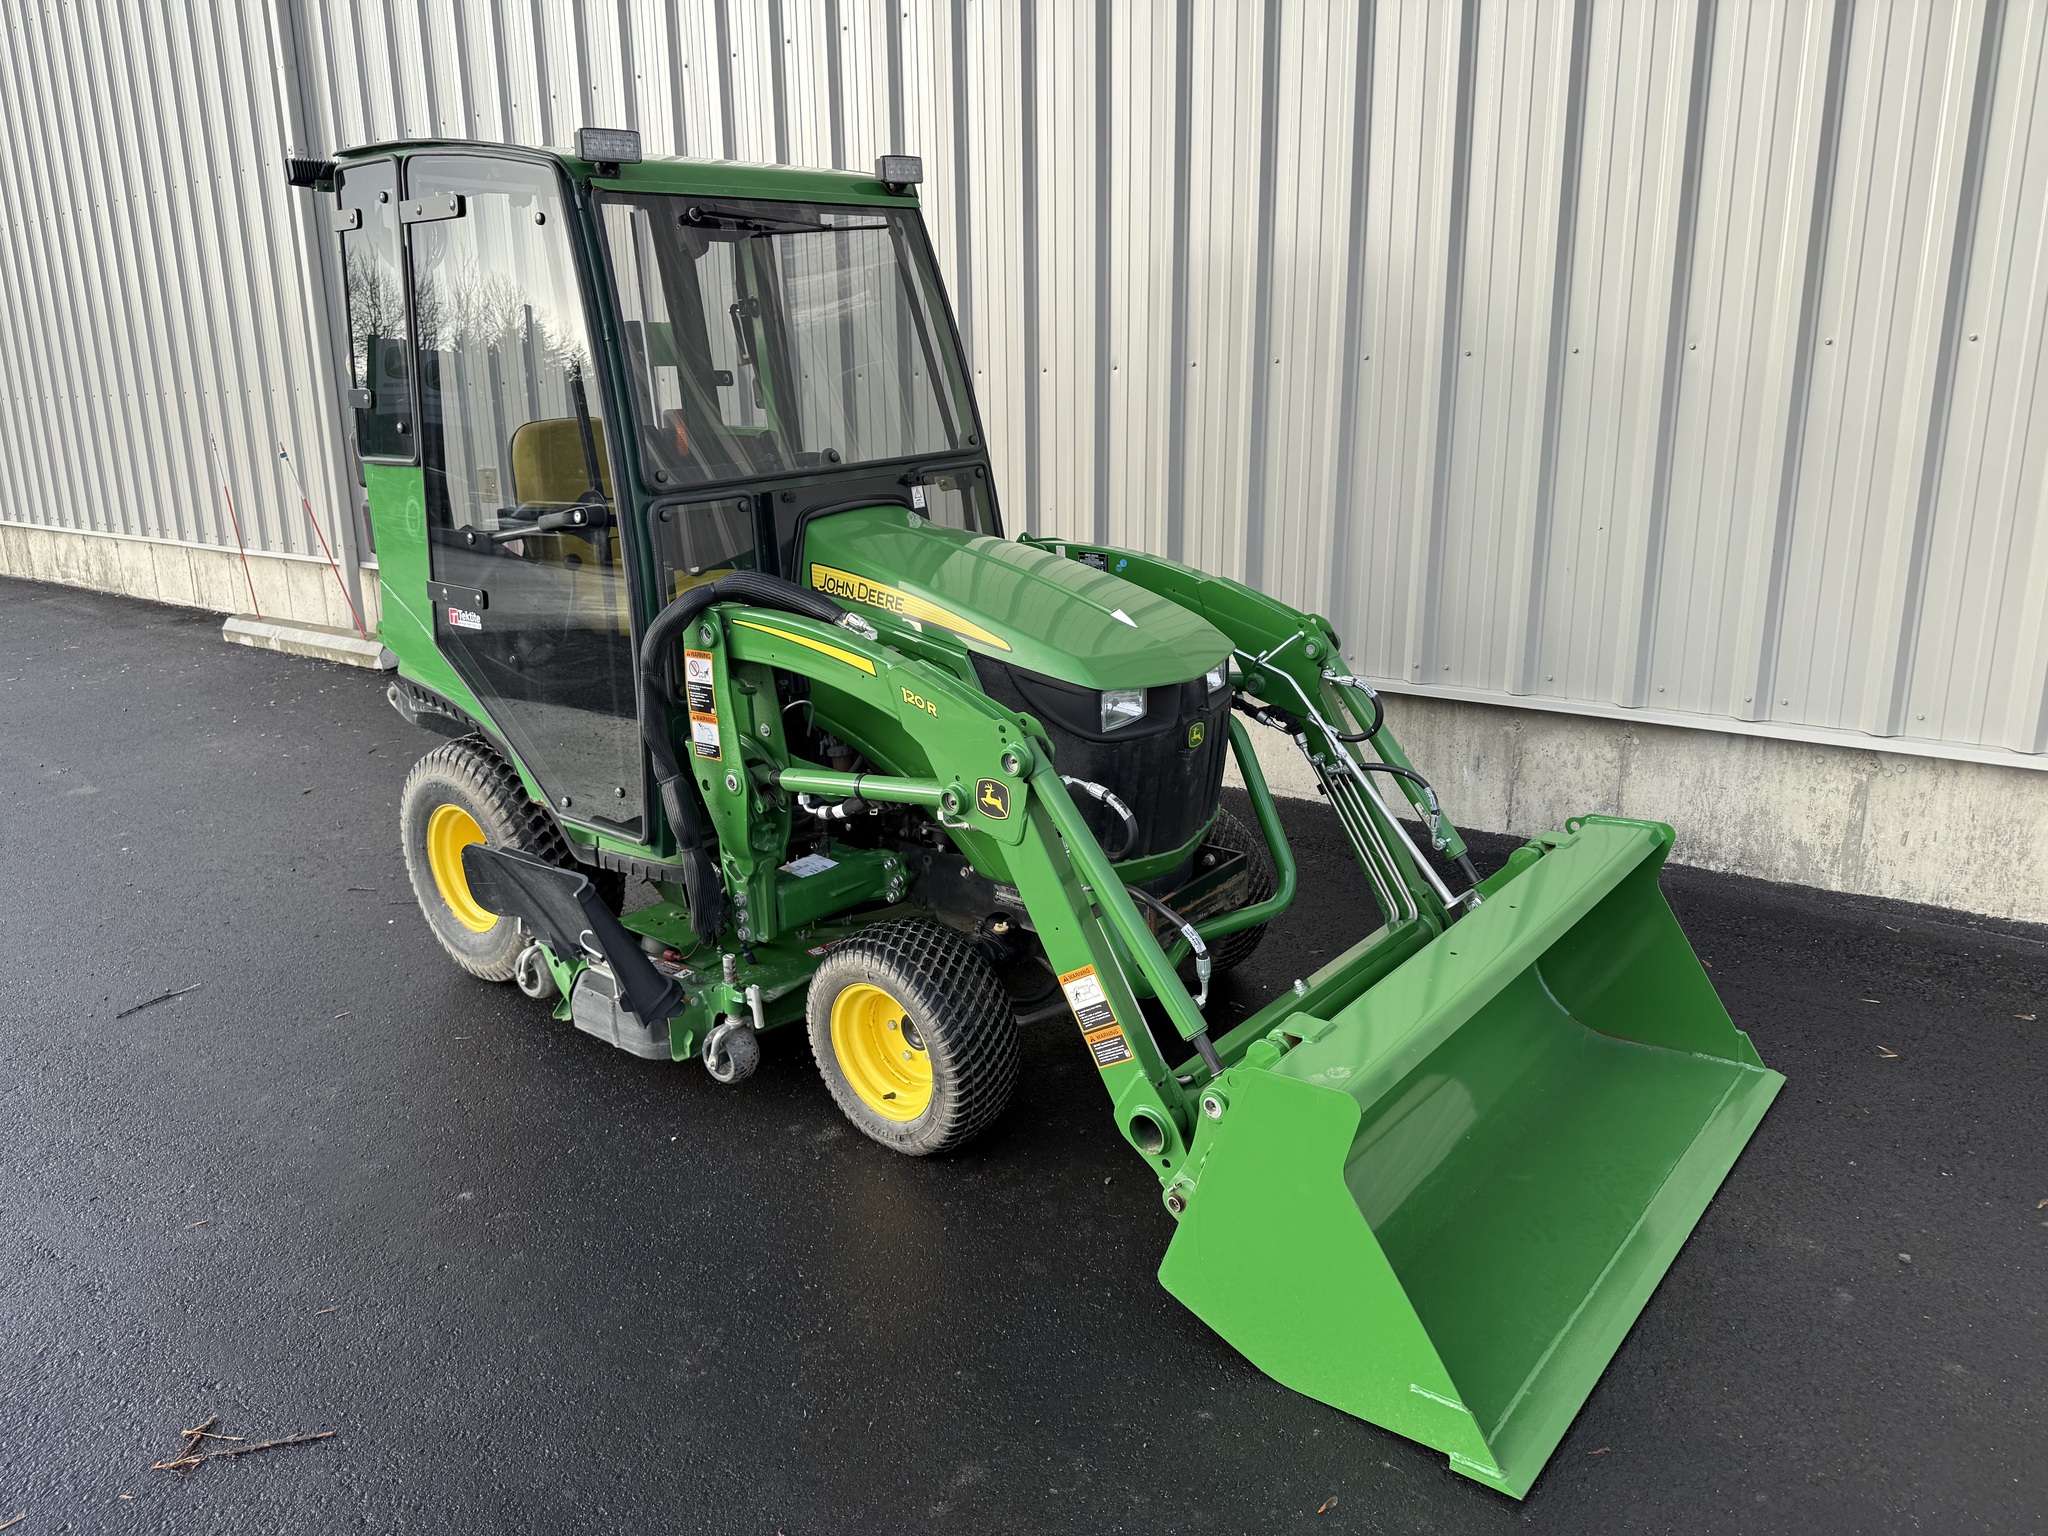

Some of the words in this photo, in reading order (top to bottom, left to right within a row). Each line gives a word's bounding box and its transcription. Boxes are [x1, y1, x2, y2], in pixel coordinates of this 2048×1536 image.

[819, 573, 855, 598] JOHN
[857, 582, 905, 613] DEERE
[691, 651, 712, 660] WARNING
[1069, 968, 1091, 980] WARNING
[1096, 1029, 1119, 1040] WARNING
